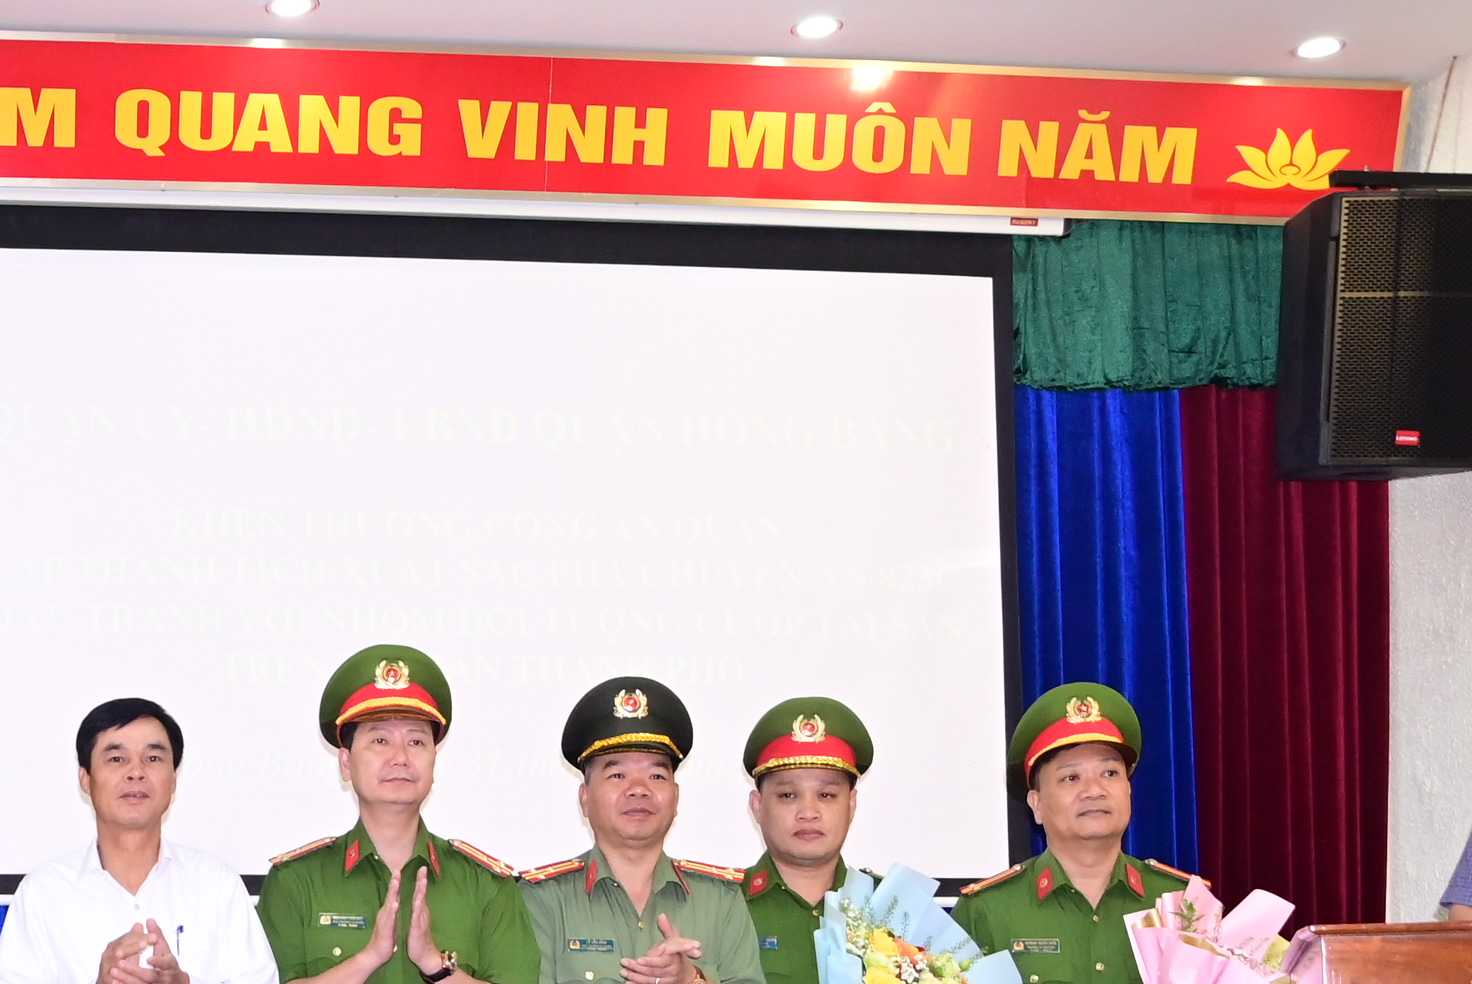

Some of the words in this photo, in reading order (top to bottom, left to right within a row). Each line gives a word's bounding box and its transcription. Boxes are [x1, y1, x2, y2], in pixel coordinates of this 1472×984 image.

[115, 89, 423, 157] QUANG
[458, 99, 668, 167] VINH
[708, 102, 972, 176] MUÔN
[998, 109, 1198, 186] NĂM
